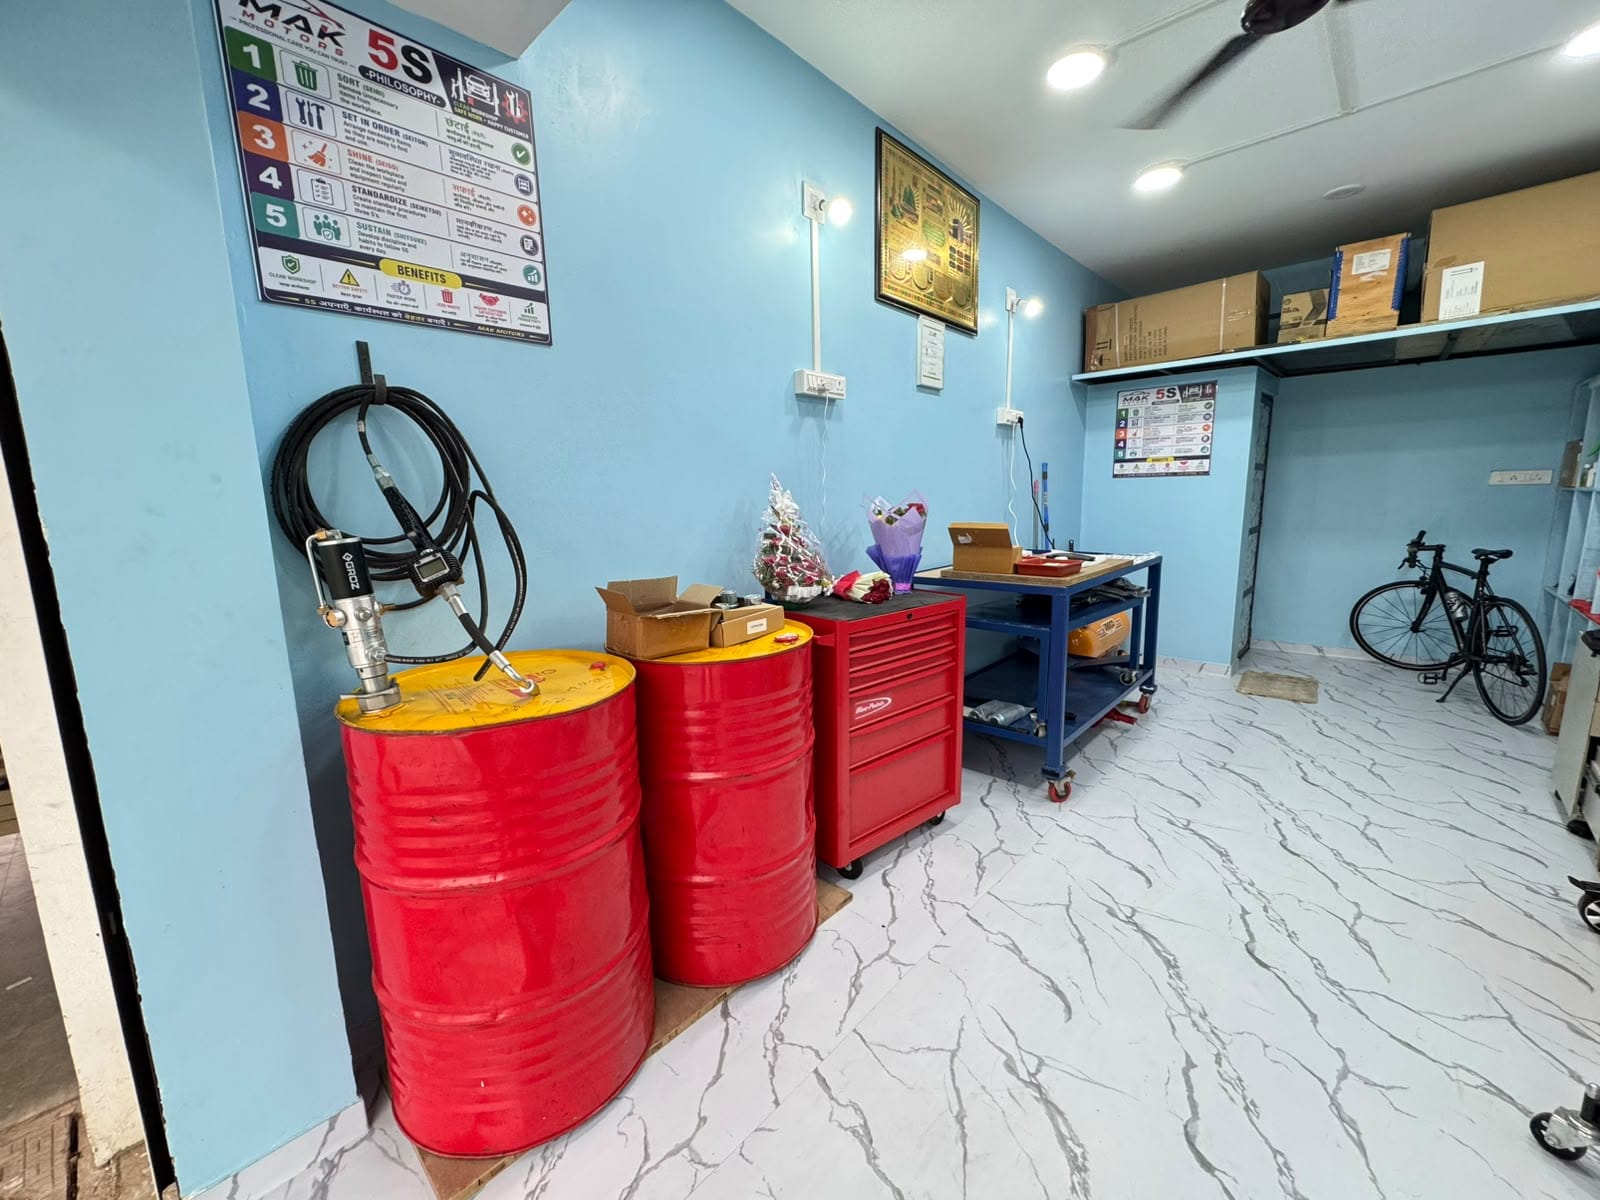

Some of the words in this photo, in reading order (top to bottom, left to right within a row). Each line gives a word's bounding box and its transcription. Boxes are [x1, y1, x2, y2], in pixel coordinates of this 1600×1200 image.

[238, 0, 346, 48] MAK
[242, 10, 344, 56] MOTORS
[242, 44, 261, 69] 1
[368, 28, 432, 84] 5S
[337, 73, 359, 88] SORT
[246, 83, 271, 111] 2
[342, 111, 358, 123] SET
[360, 116, 370, 127] IN
[372, 121, 400, 137] ORDER
[252, 124, 276, 150] 3
[347, 149, 373, 163] SHINE
[259, 166, 282, 190] 4
[352, 184, 408, 207] STANDARDIZE
[266, 203, 287, 228] 5
[356, 221, 391, 236] SUSTAIN
[397, 264, 447, 284] BENEFITS
[477, 325, 495, 333] MAK
[496, 328, 525, 338] MOTORS
[1156, 387, 1177, 400] 5S
[345, 561, 360, 590] GROZ
